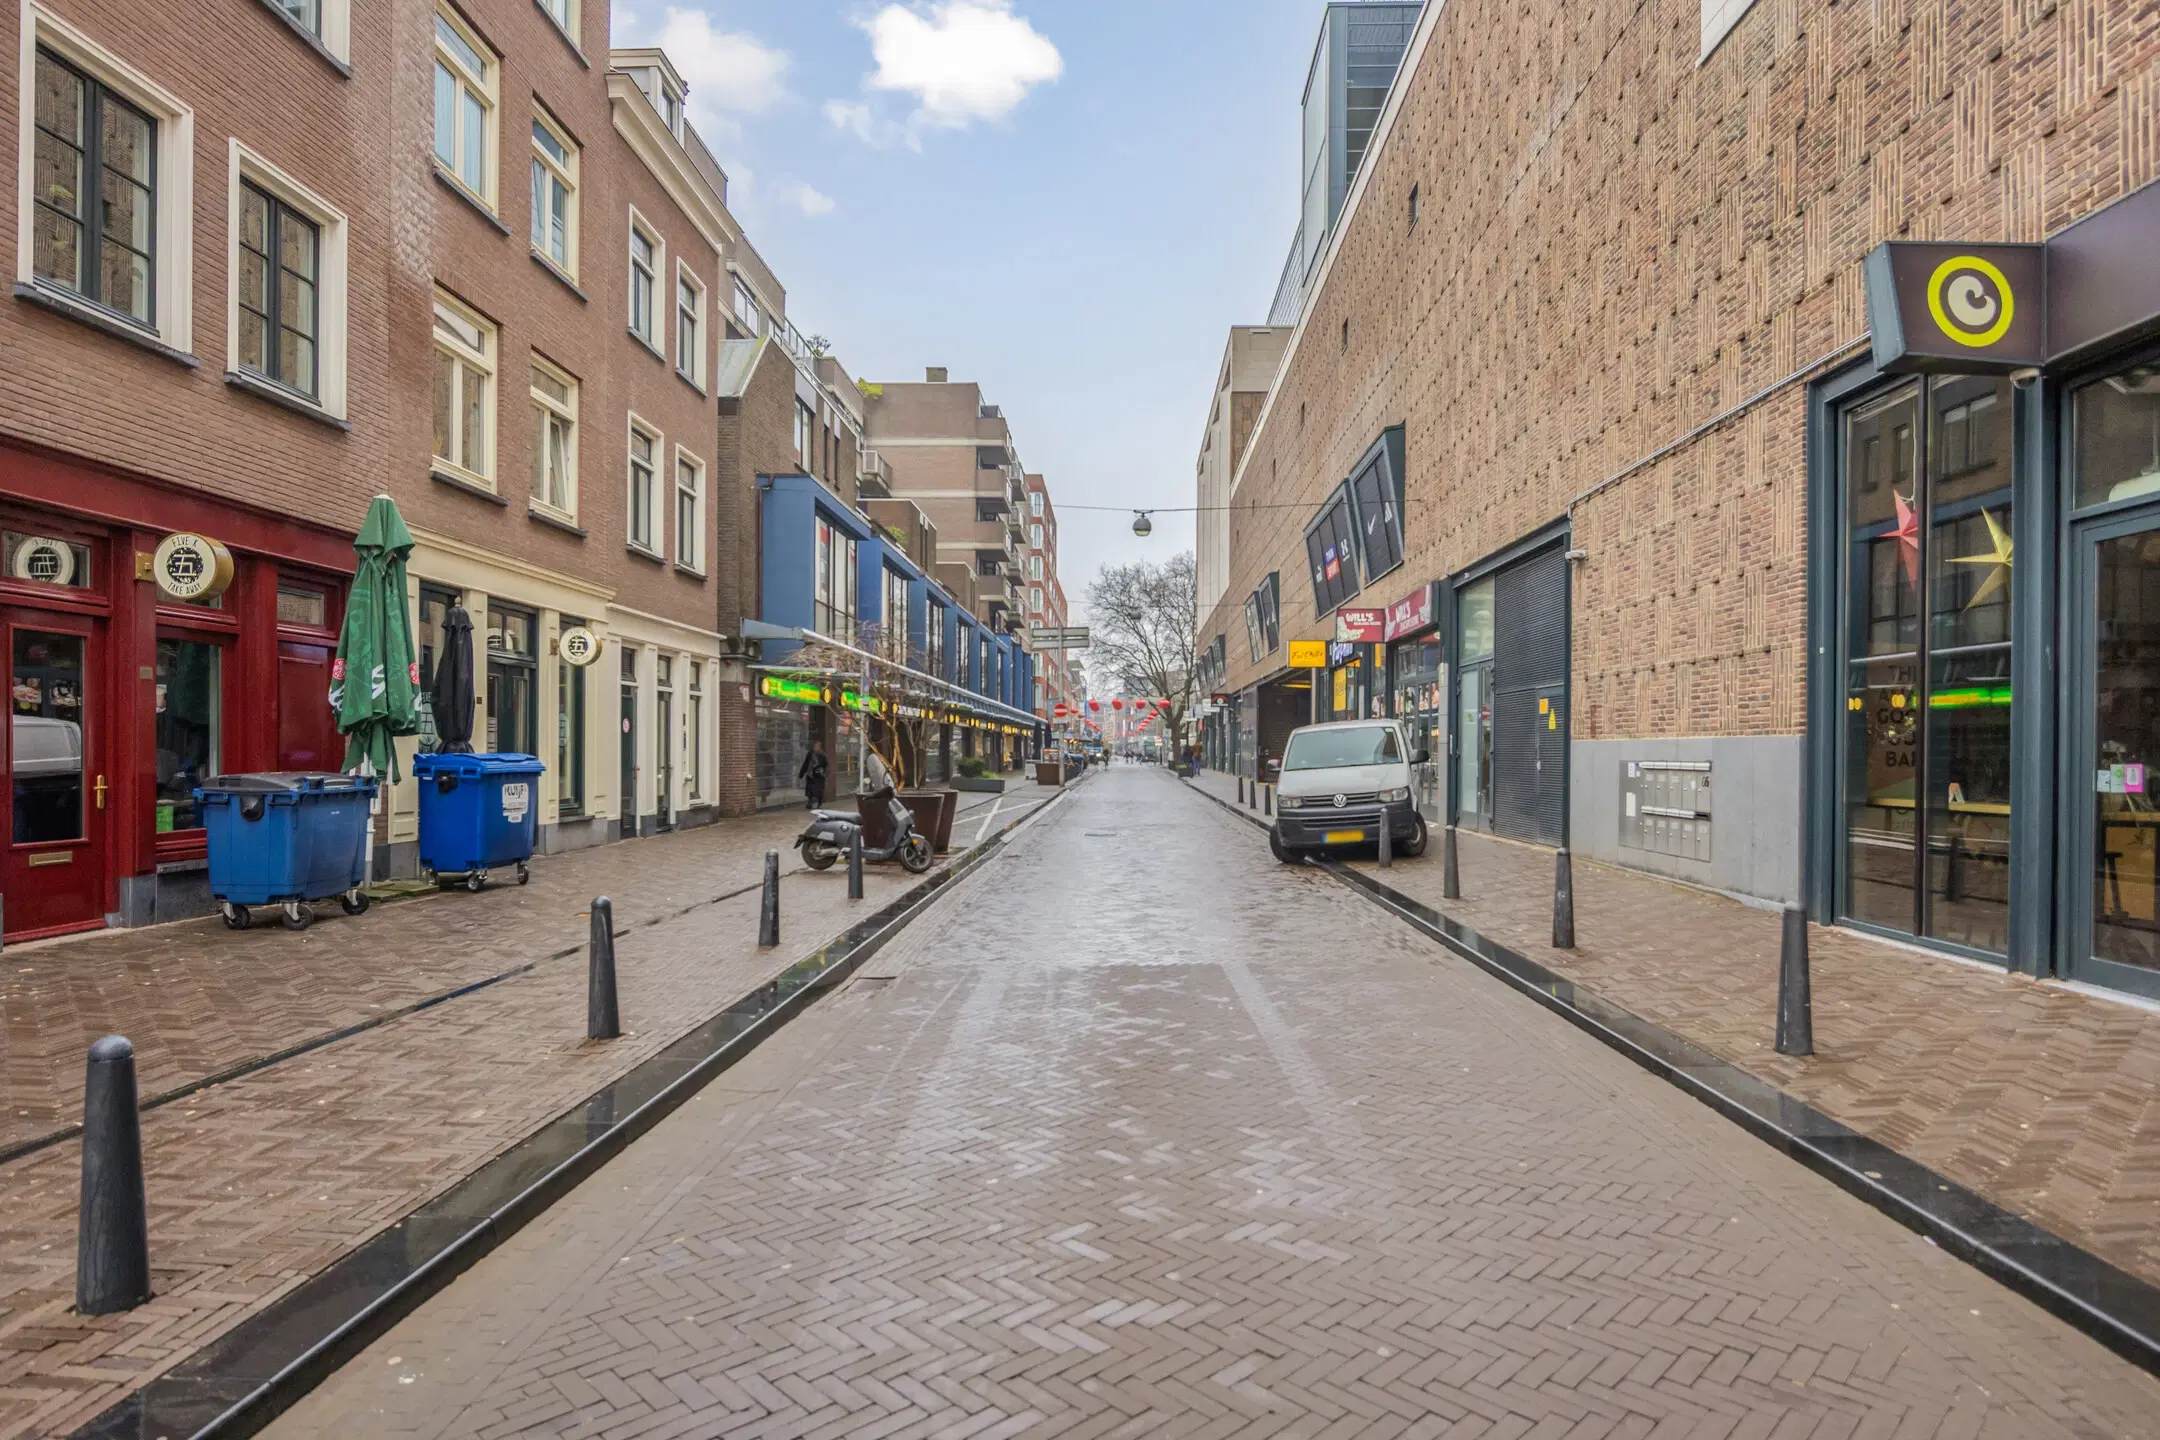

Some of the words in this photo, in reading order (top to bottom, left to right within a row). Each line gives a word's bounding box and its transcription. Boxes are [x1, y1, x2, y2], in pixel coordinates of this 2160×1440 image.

[171, 536, 189, 548] FIVE
[192, 539, 200, 547] K
[167, 582, 183, 595] TAKE
[186, 582, 202, 595] AWAY
[1345, 612, 1375, 622] WILL'S
